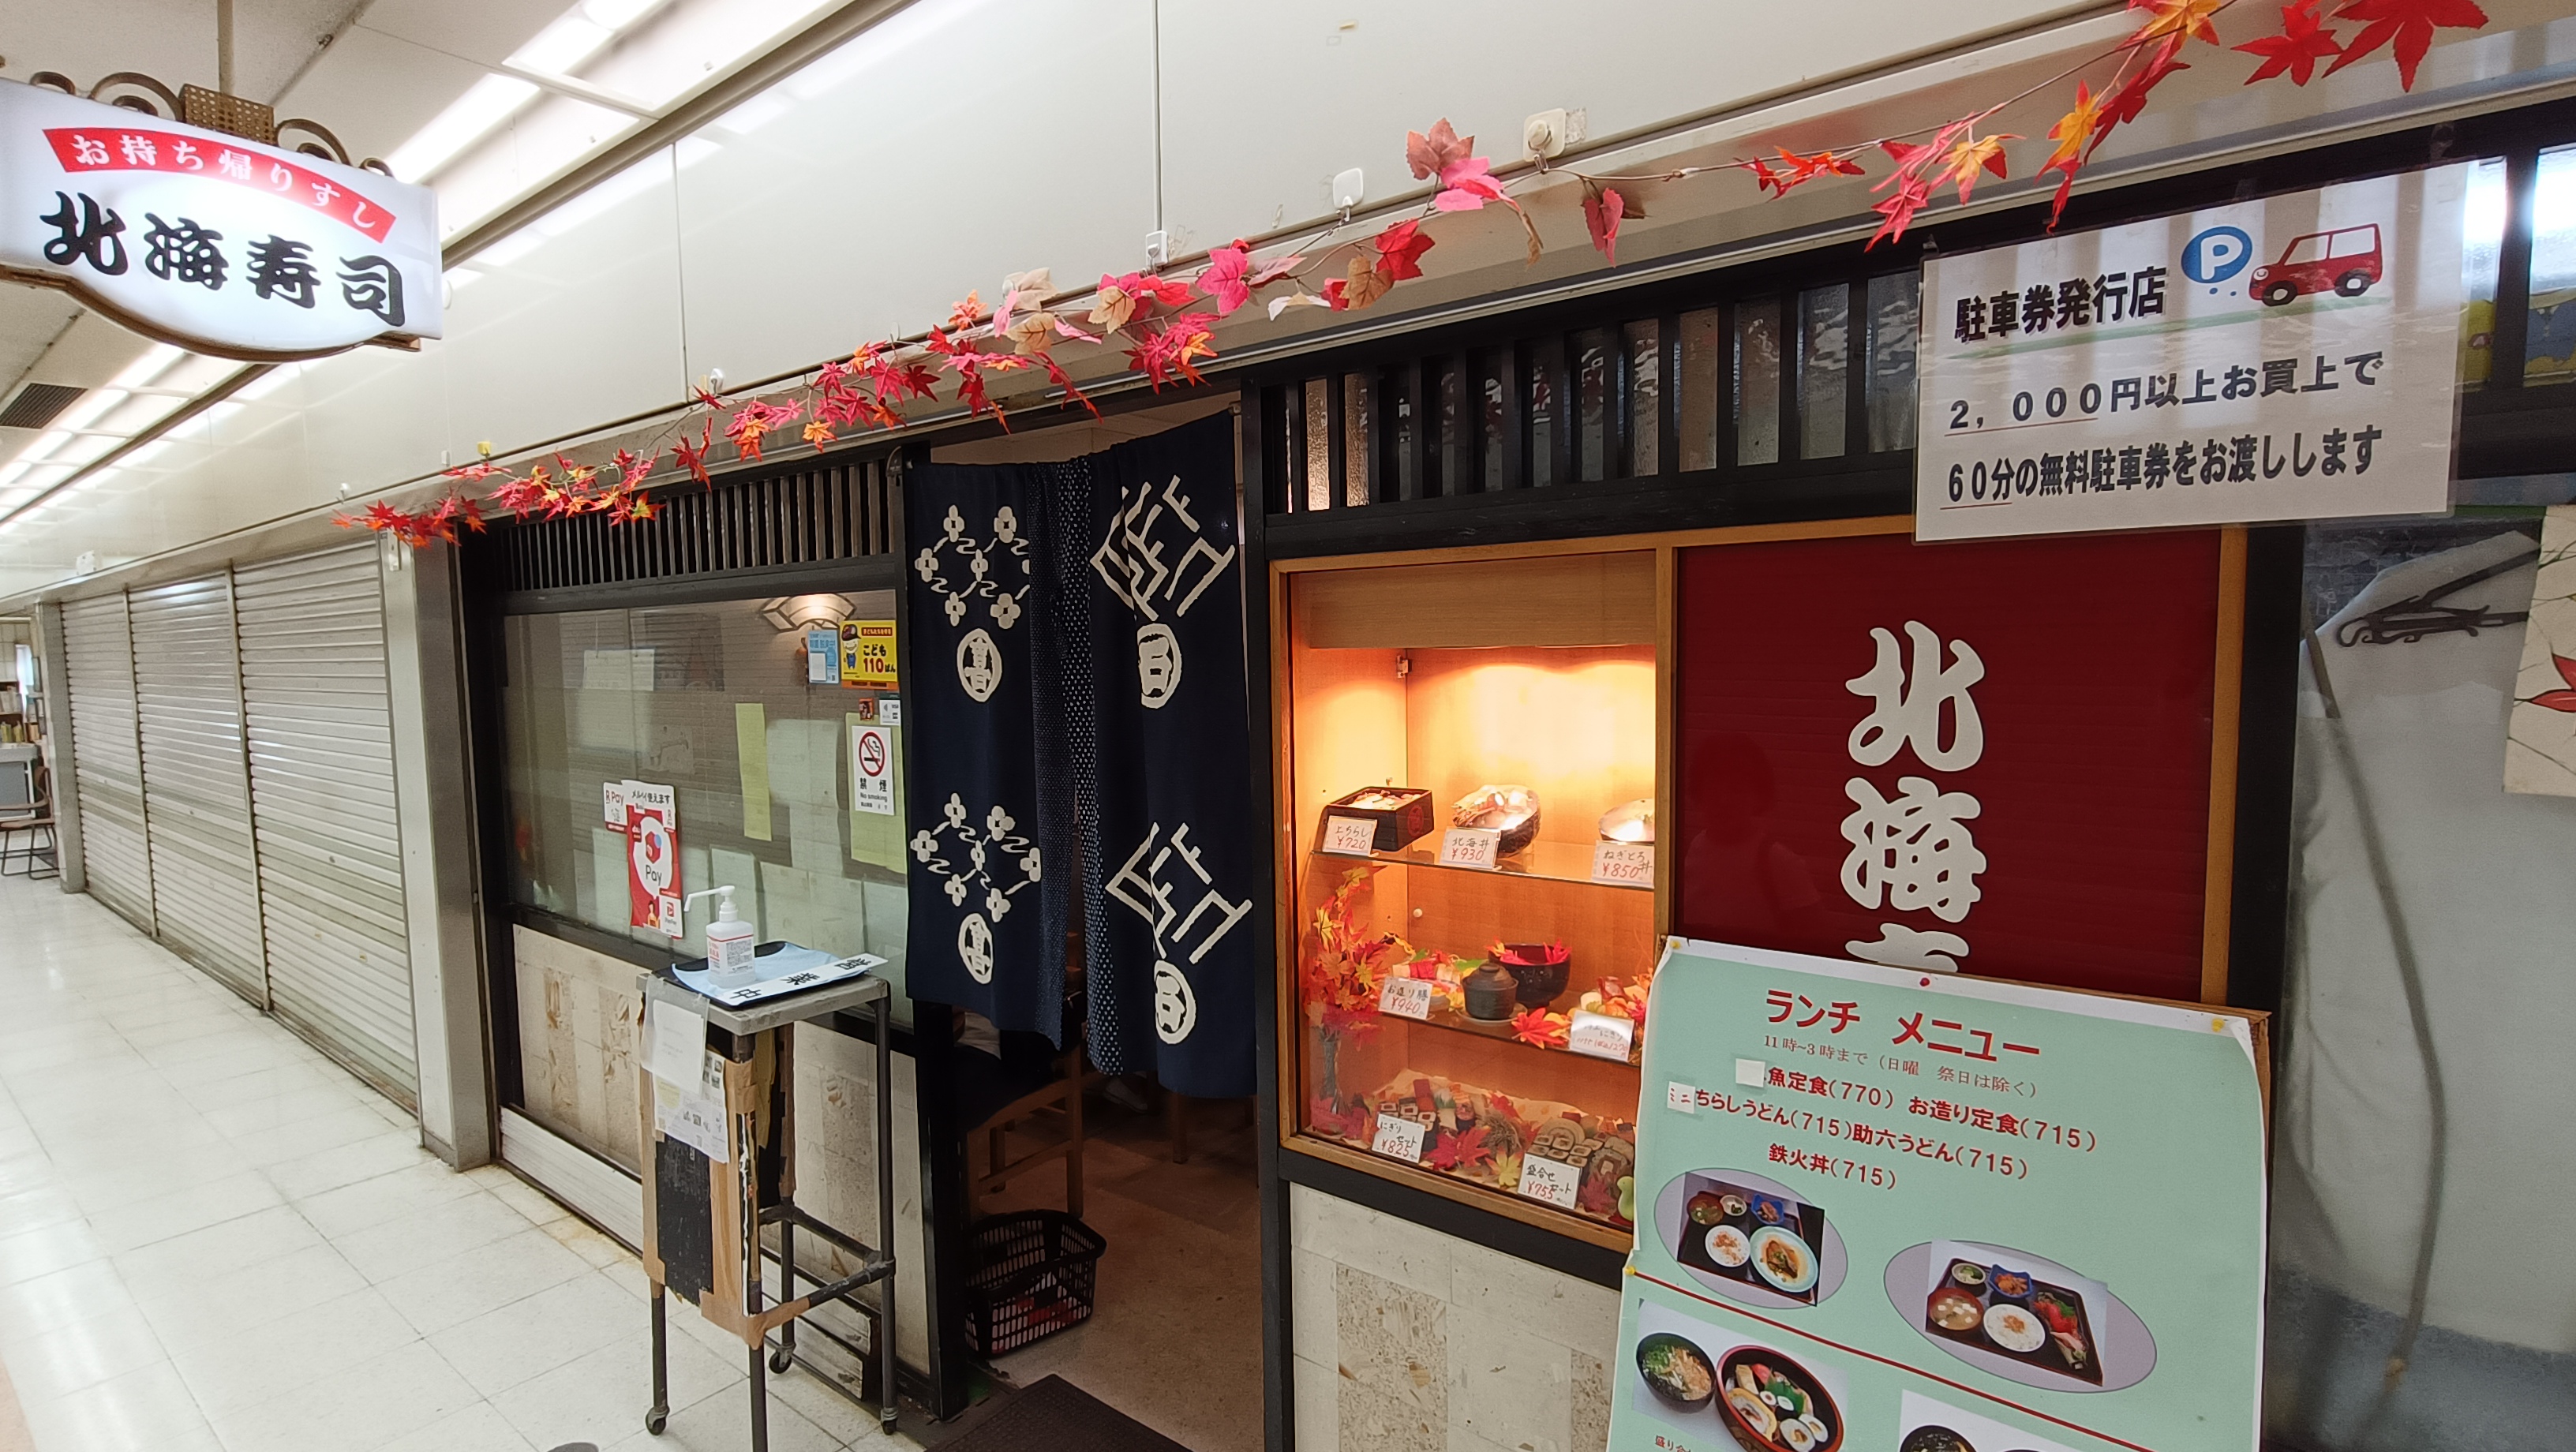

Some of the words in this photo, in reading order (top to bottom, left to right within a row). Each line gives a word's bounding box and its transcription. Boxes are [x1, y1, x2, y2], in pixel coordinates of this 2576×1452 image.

[71, 134, 379, 229] お持ち帰りすし
[39, 190, 406, 327] 北海寿司
[1954, 266, 2168, 342] 駐車券発行店
[1948, 425, 2383, 501] 60分の無料駐車券をお渡しします
[863, 643, 887, 657] こども
[860, 777, 887, 792] 禁煙
[612, 791, 624, 806] Pay
[867, 794, 888, 803] smoking
[1335, 825, 1370, 837] 上ちらし
[1337, 836, 1366, 849] ¥720
[1451, 848, 1485, 861] ¥930
[1603, 849, 1645, 863] ねぎとろ
[646, 864, 662, 886] Pay
[1603, 862, 1639, 878] ¥850
[1391, 996, 1421, 1014] ¥940
[1766, 989, 1861, 1035] ランチ
[1892, 1012, 2041, 1063] メニュー
[1380, 1121, 1402, 1134] にぎり
[1908, 1096, 2096, 1152] お造り定食(715)
[1381, 1138, 1410, 1157] ¥825
[1526, 1163, 1556, 1182] 盛合せ
[1769, 1143, 1896, 1191] 鉄火丼(715)
